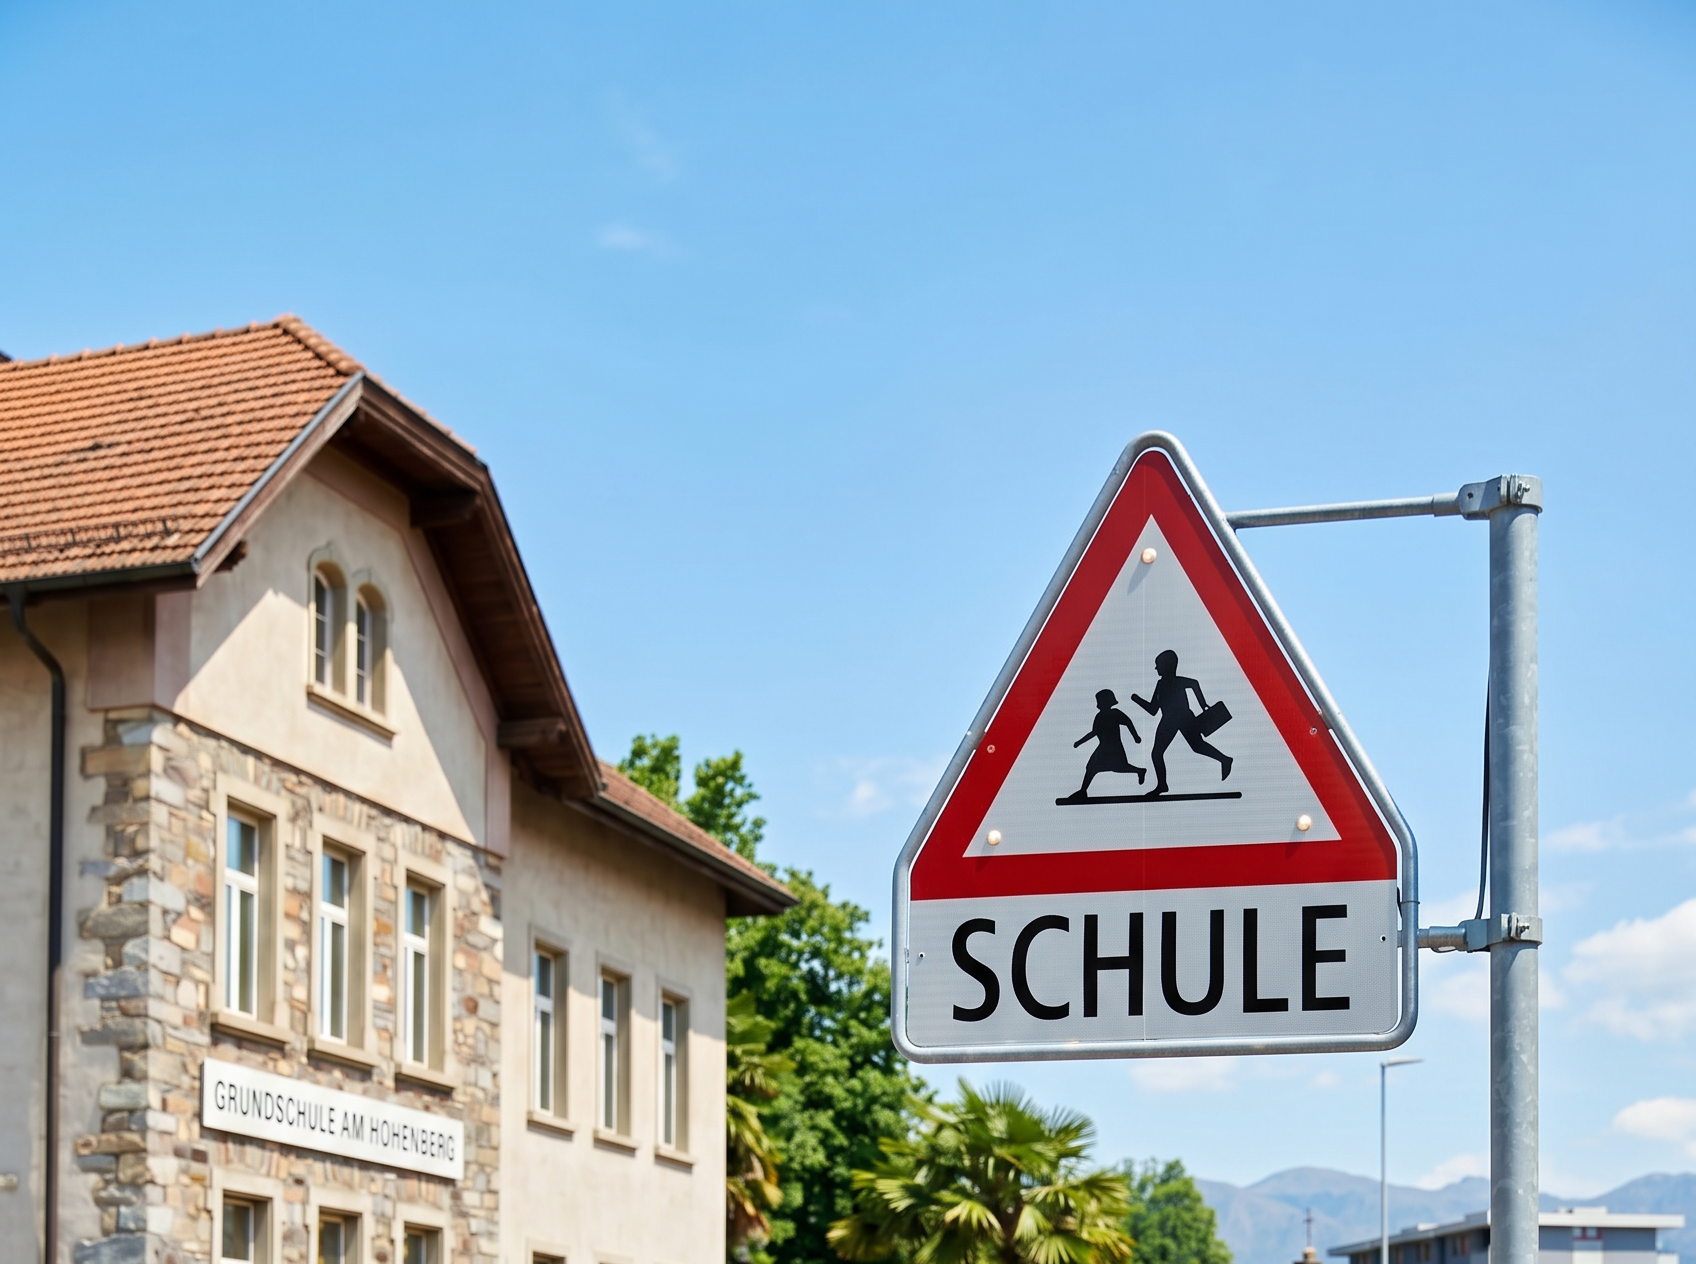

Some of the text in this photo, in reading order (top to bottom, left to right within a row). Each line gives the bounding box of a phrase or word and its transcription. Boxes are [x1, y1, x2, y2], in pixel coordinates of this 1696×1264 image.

[951, 904, 1350, 1022] SCHULE
[215, 1080, 455, 1162] GRUNDSCHULE AM HOHENBERG
